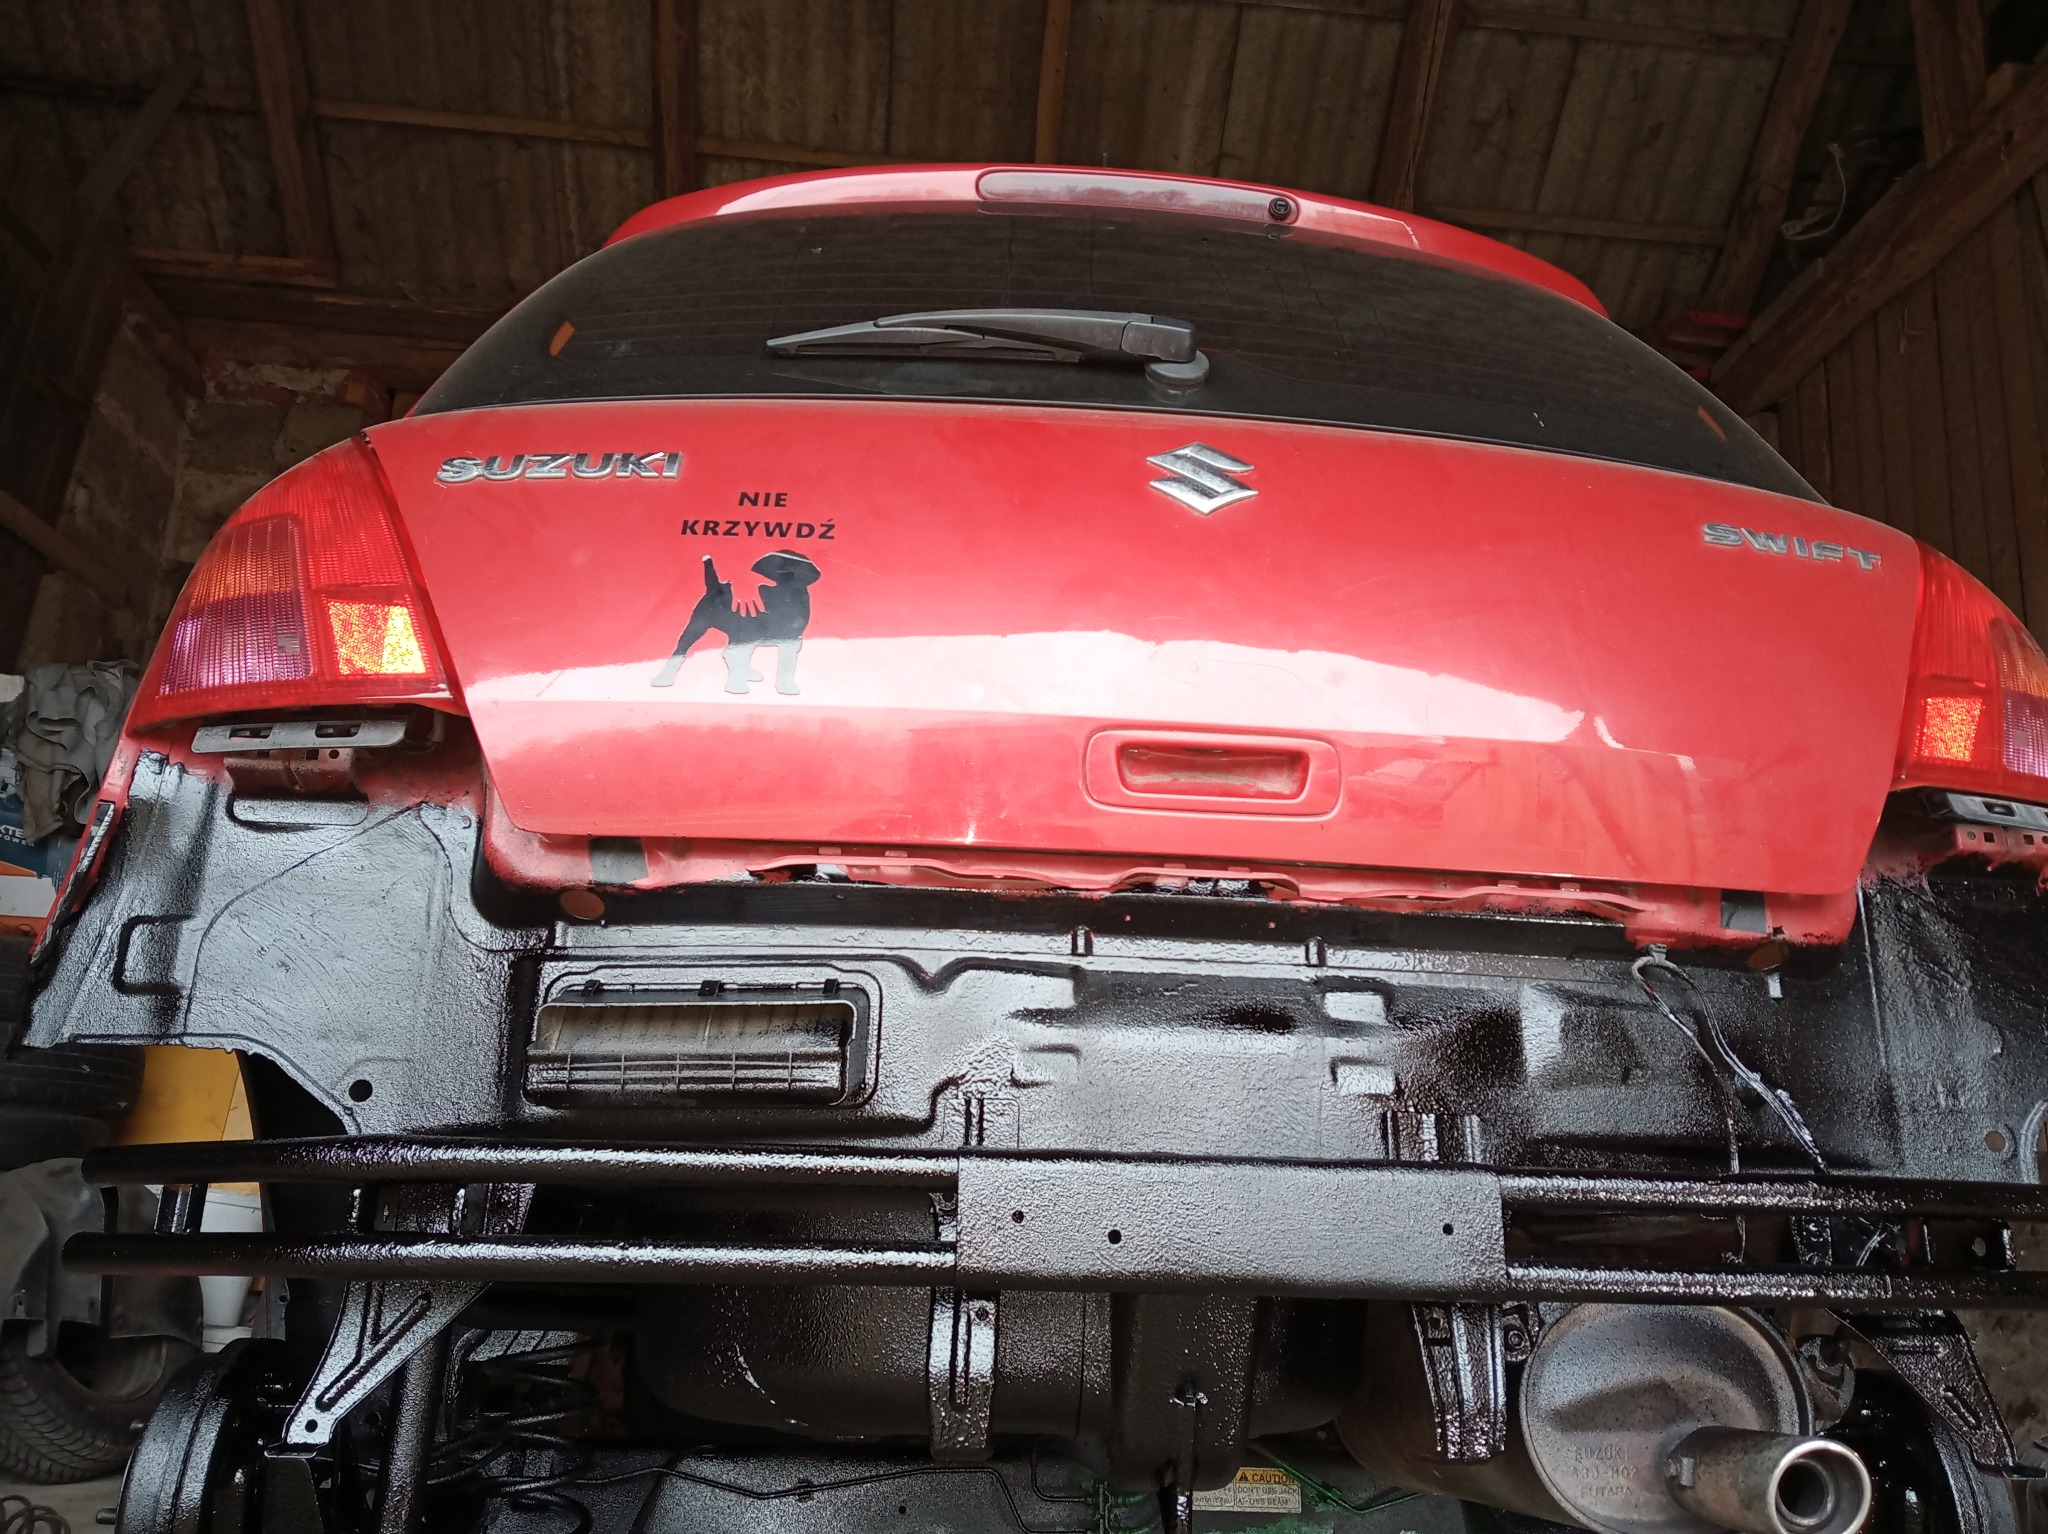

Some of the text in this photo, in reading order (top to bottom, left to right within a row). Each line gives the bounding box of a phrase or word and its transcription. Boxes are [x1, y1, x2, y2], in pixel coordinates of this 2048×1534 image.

[436, 451, 683, 483] SUZUKI
[738, 491, 788, 508] NIE
[680, 517, 836, 540] KRZYWDŹ
[1703, 522, 1882, 571] SWIFT
[1262, 1486, 1277, 1495] USE
